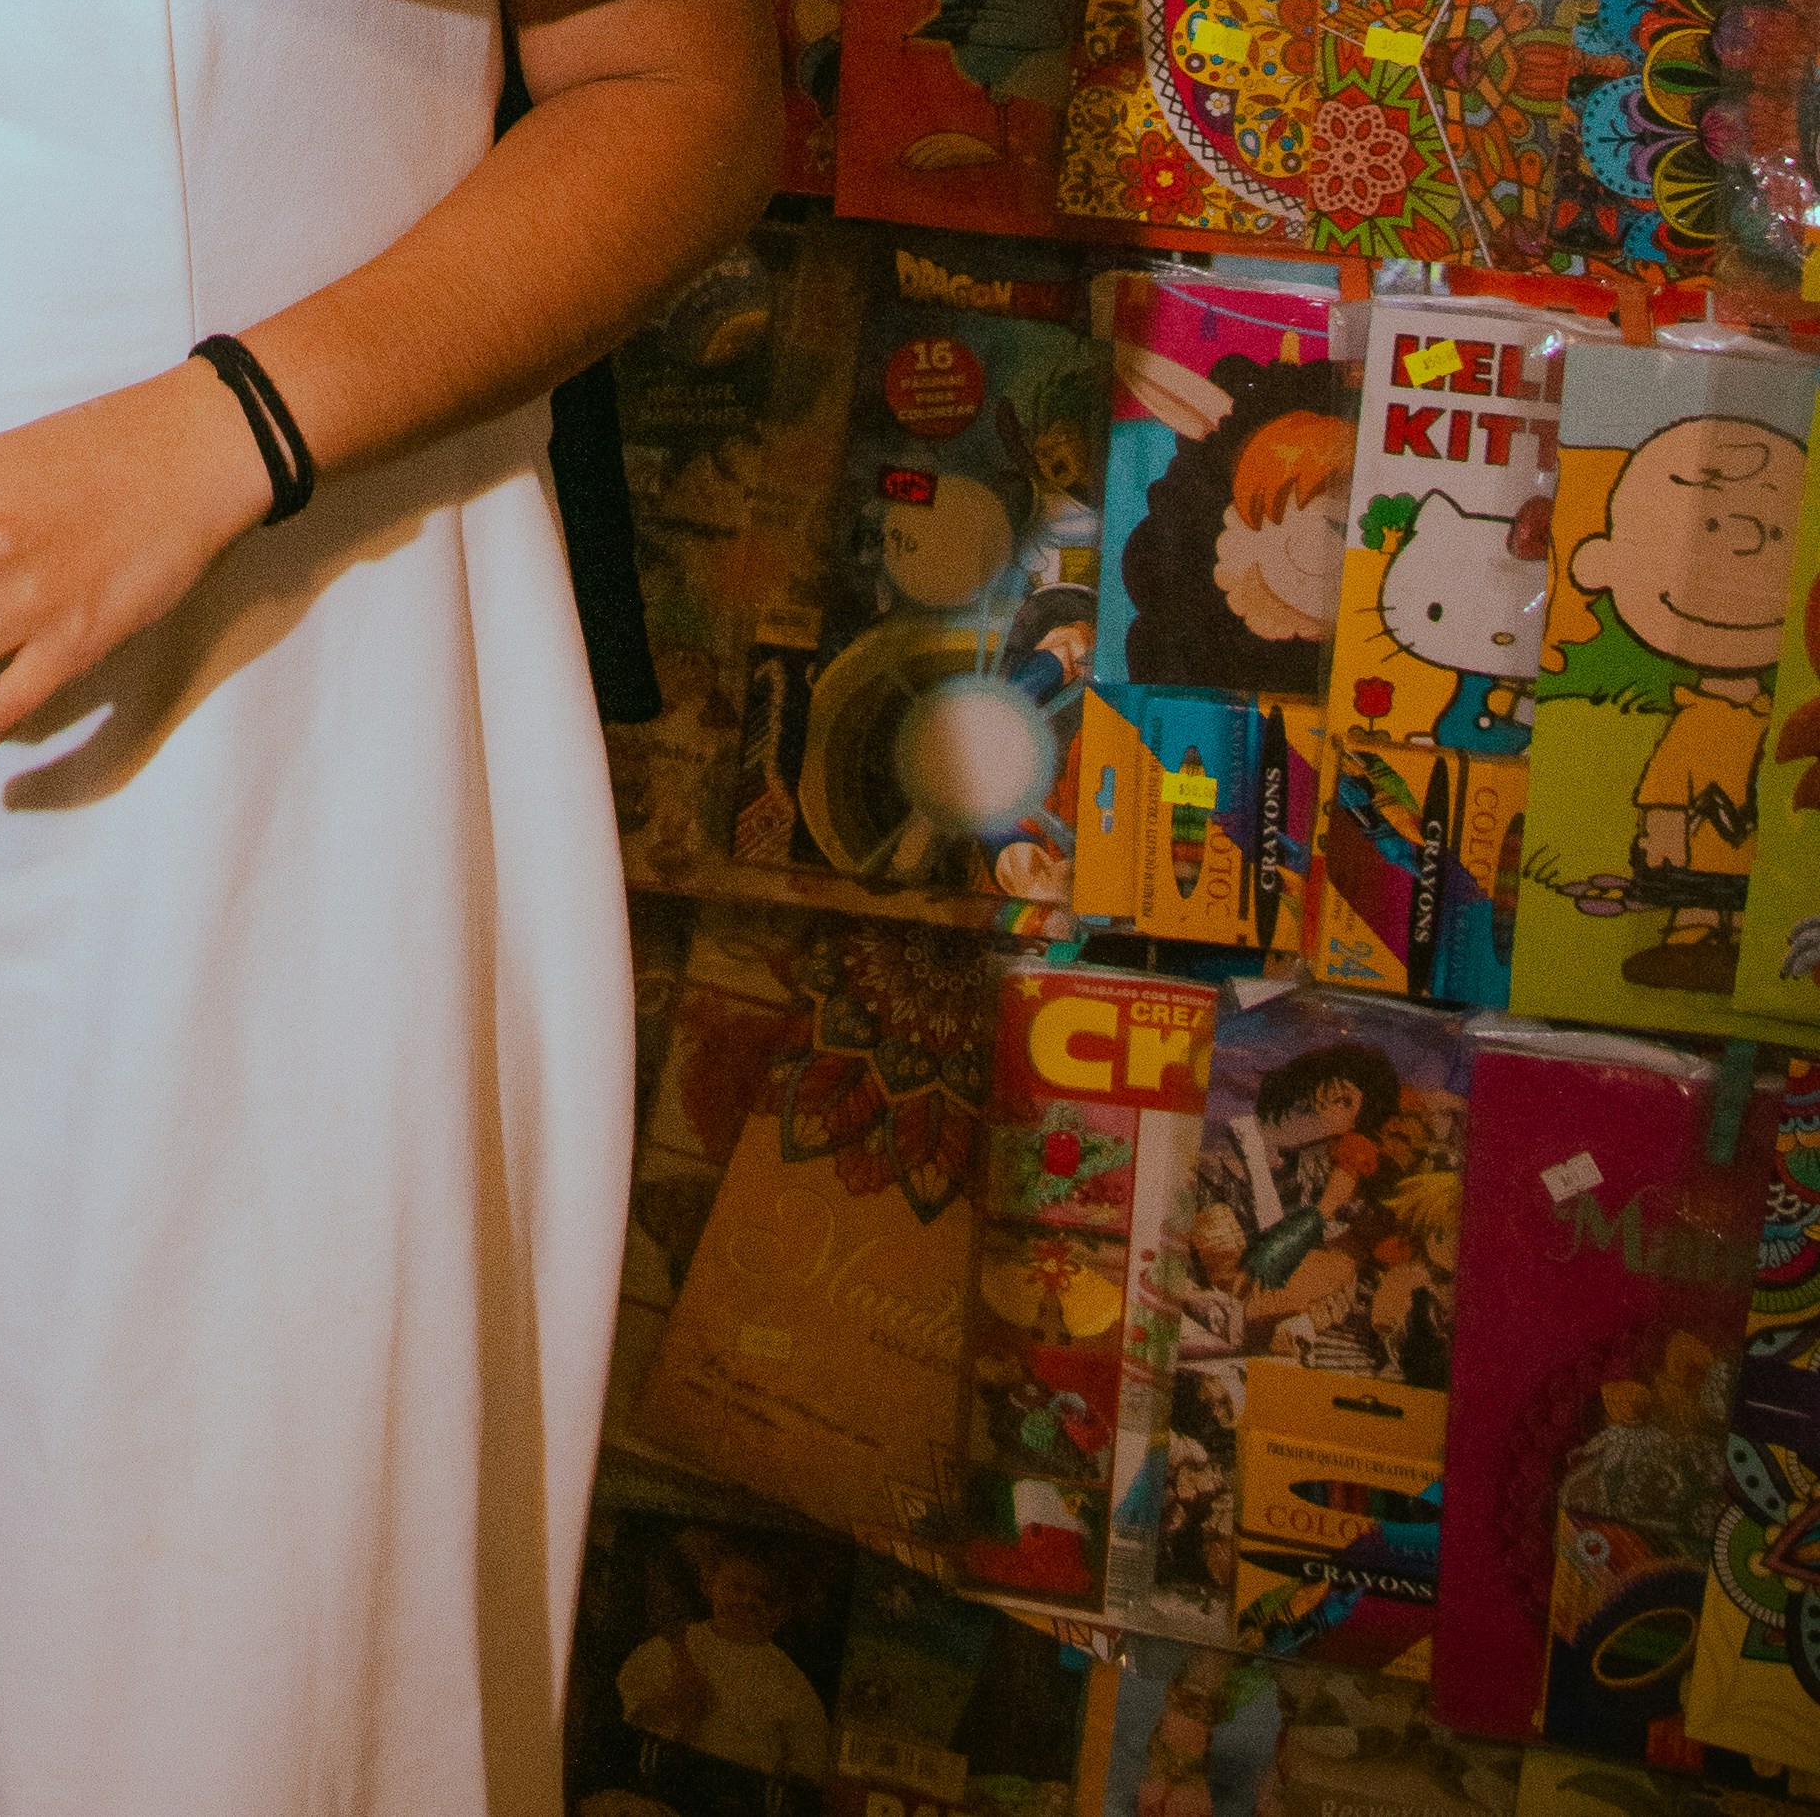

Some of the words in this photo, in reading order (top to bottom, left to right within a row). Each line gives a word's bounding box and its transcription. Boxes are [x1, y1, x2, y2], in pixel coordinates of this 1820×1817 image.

[913, 340, 955, 371] 16
[1260, 767, 1280, 893] CRAYONS
[1413, 819, 1443, 945] CRAYONS
[1327, 938, 1384, 981] 24
[1302, 1560, 1435, 1600] CRAYONS
